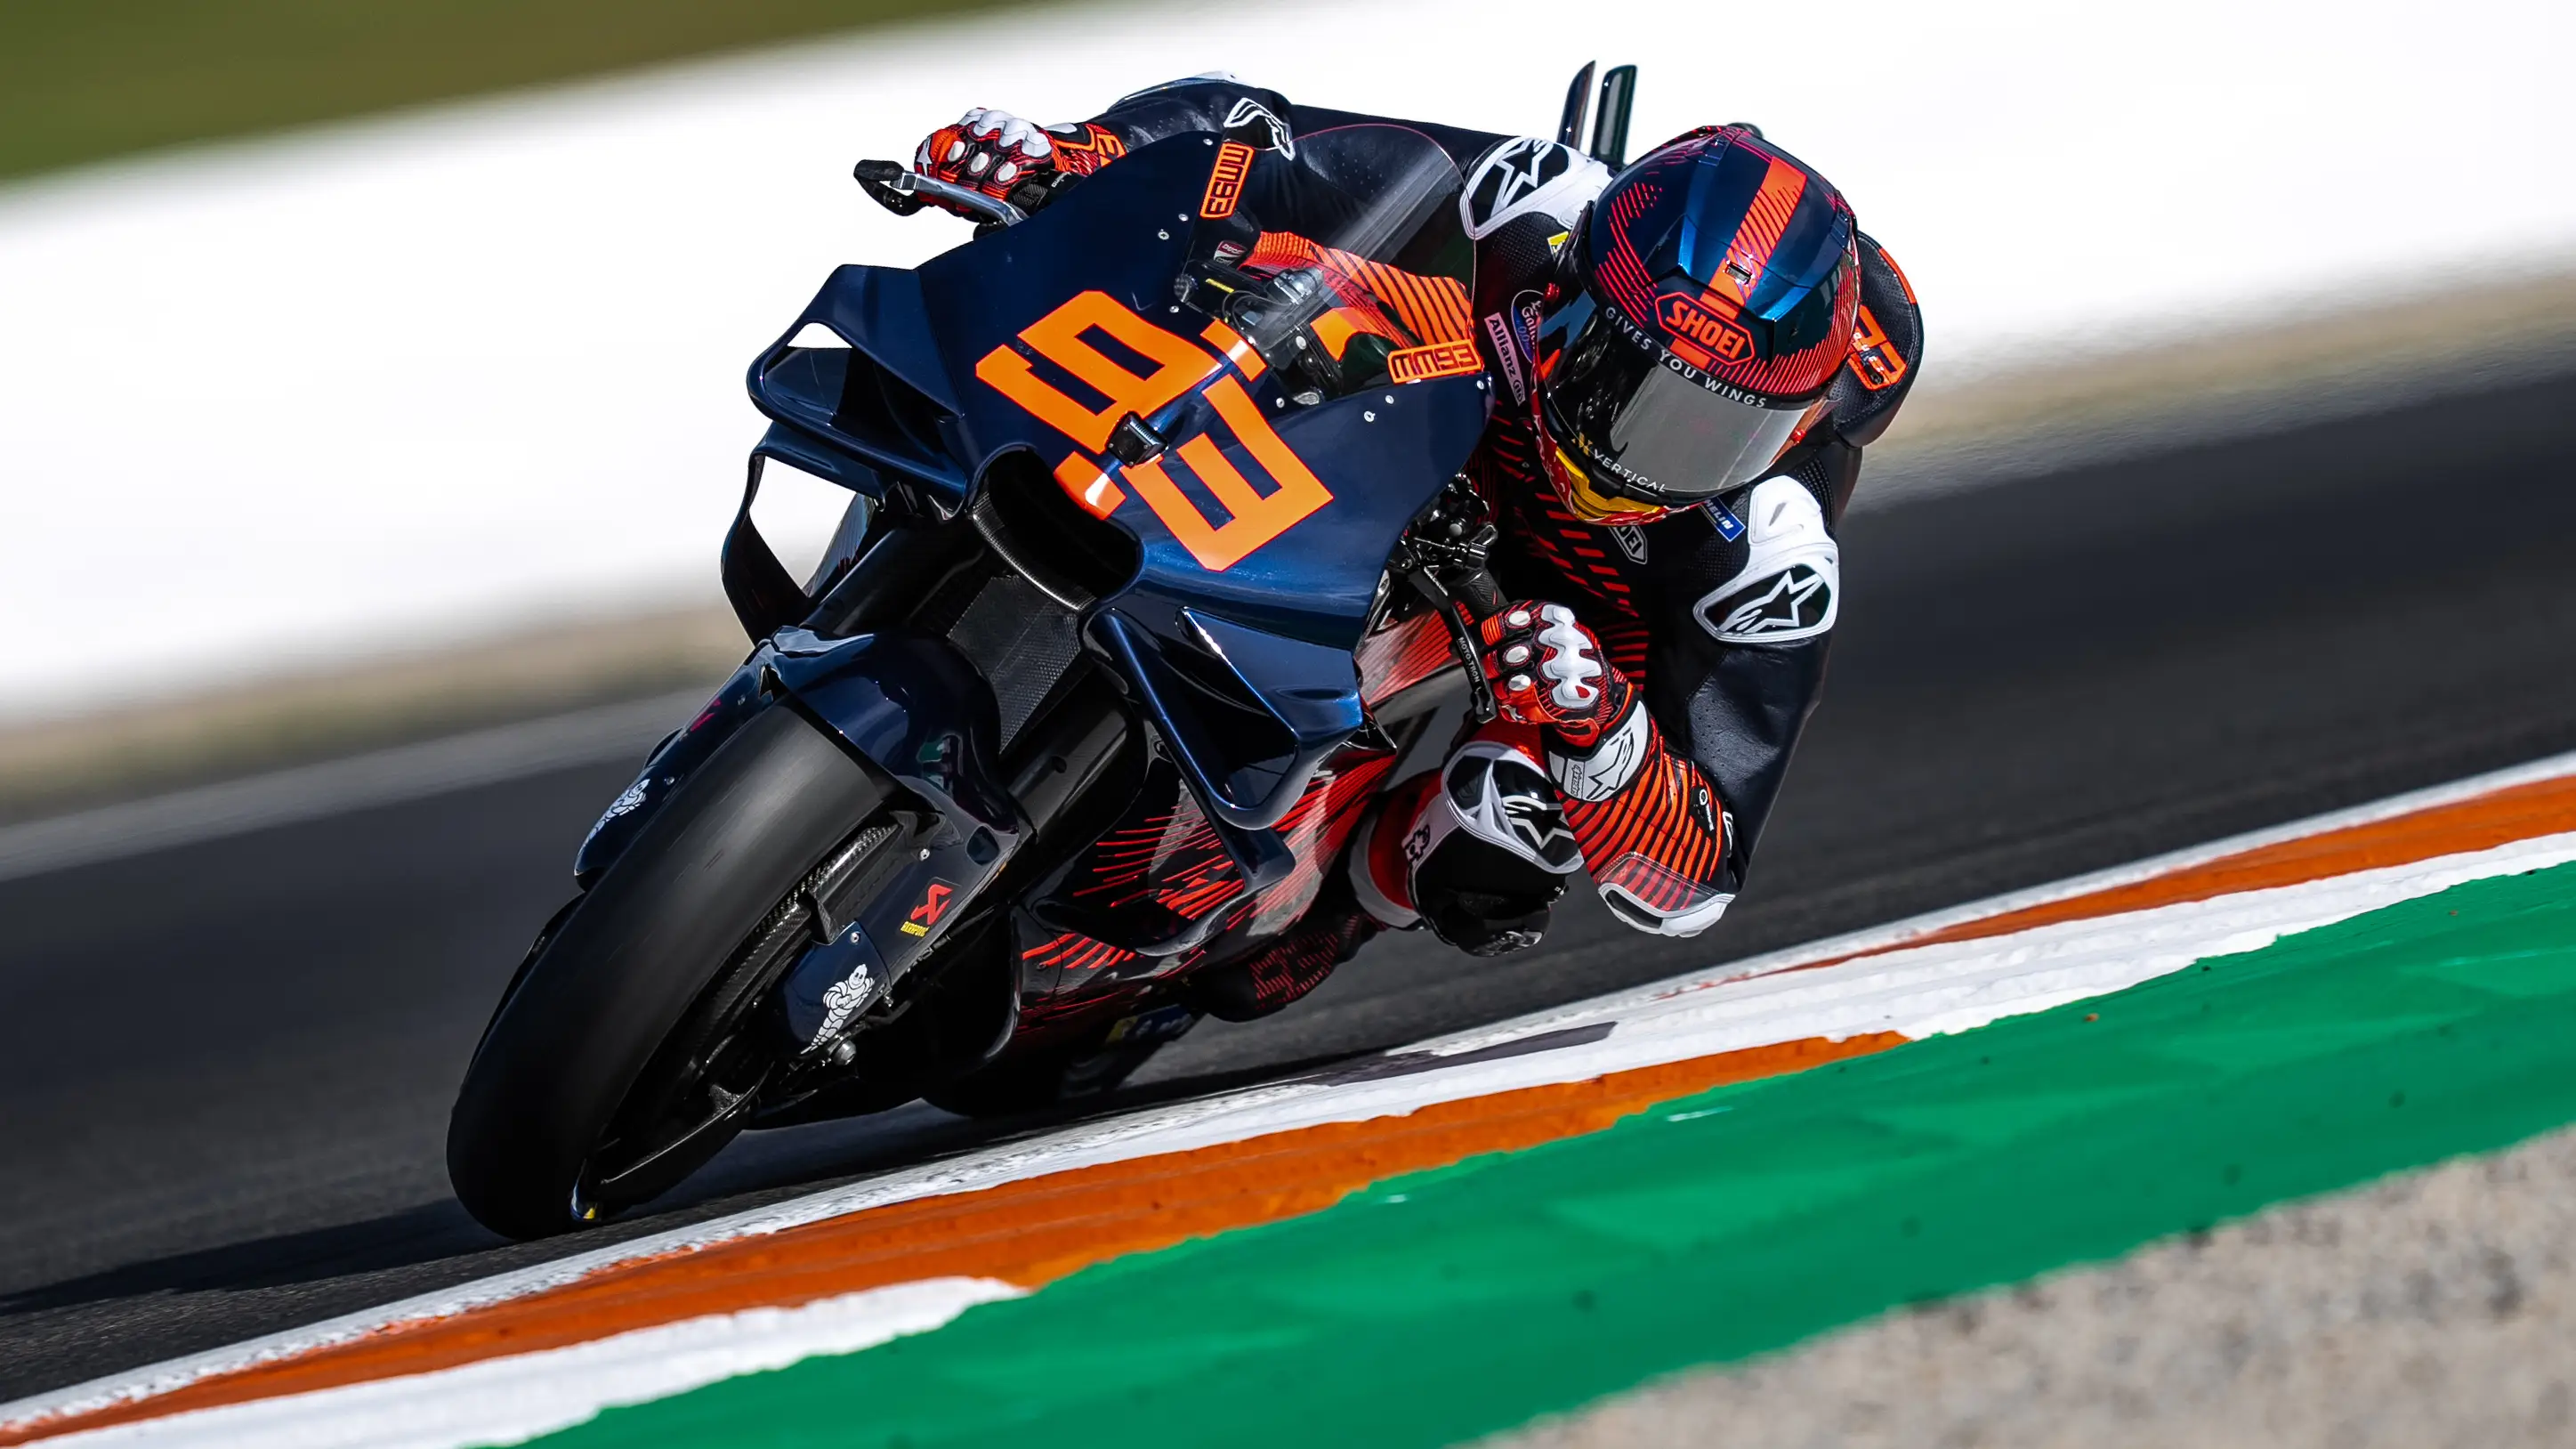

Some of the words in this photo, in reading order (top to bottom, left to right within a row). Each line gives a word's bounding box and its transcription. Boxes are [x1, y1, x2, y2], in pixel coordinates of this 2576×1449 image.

[1204, 144, 1249, 215] MM93
[1489, 318, 1516, 378] Allianz
[1605, 307, 1652, 351] GIVES
[1659, 350, 1697, 379] YOU
[1704, 377, 1767, 408] WINGS
[1666, 299, 1747, 360] SHOEI
[1392, 344, 1479, 380] MM93
[975, 290, 1334, 572] 93
[1593, 449, 1667, 493] VERTICAL
[1704, 498, 1734, 530] HELIN
[1458, 636, 1481, 683] MOTO-TRON
